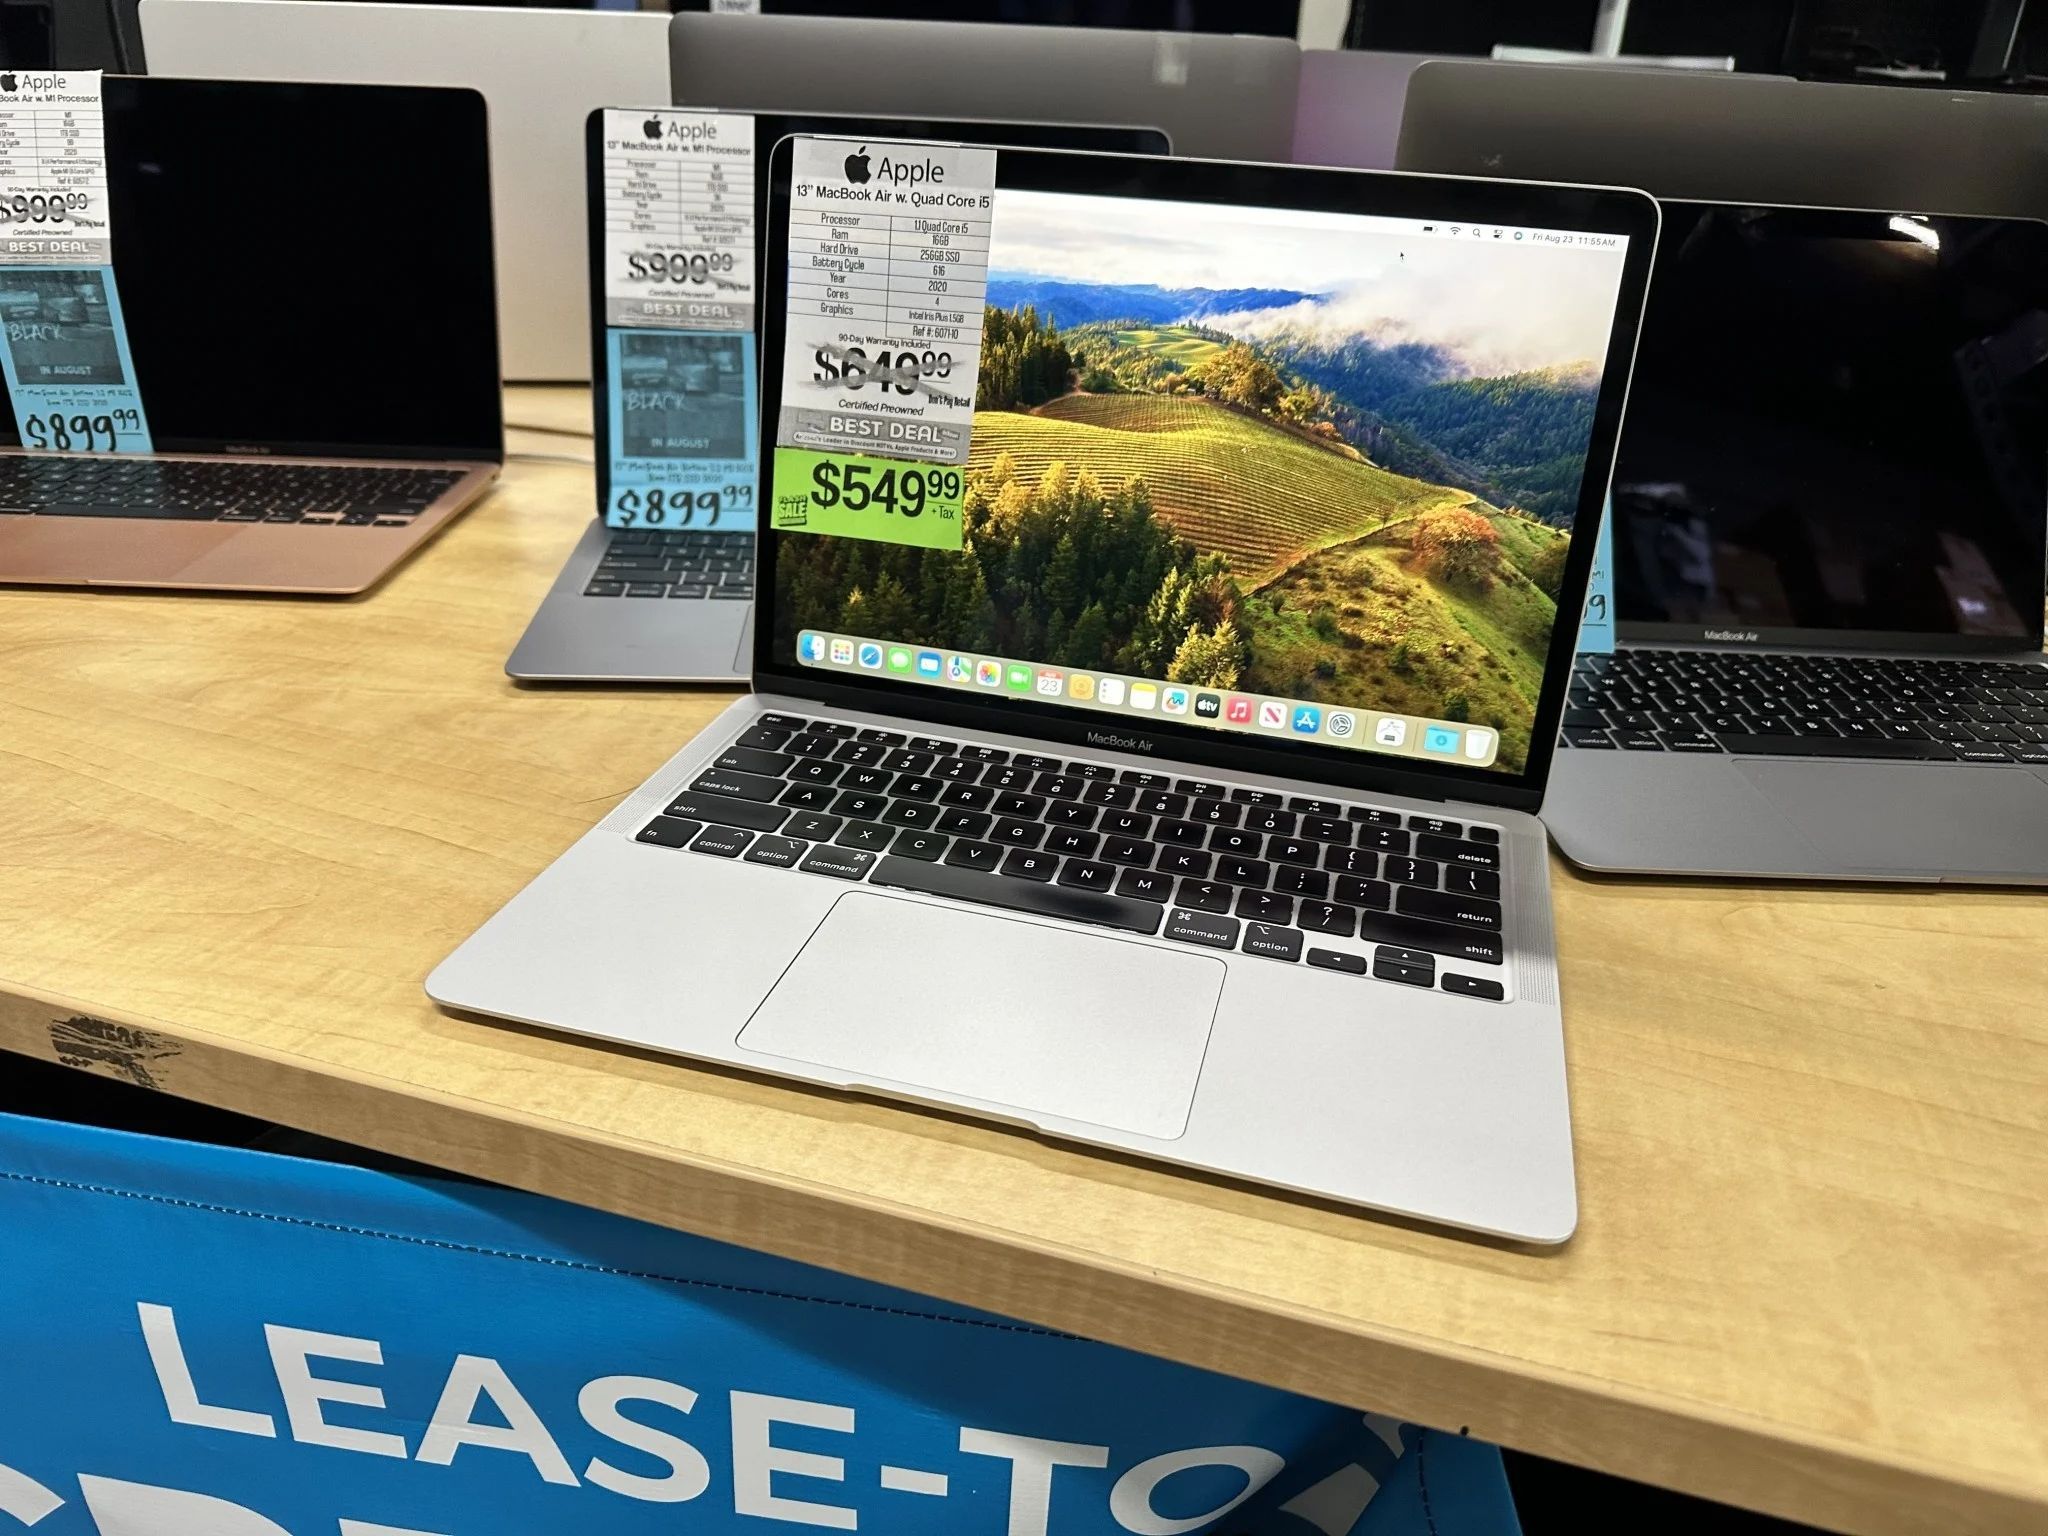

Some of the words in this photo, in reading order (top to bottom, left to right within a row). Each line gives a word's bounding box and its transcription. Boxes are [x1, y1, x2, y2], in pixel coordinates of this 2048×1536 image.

[22, 74, 66, 92] Apple
[58, 95, 98, 103] Processor
[668, 121, 717, 141] Apple
[622, 141, 663, 151] MacBook
[707, 146, 751, 156] Processor
[877, 157, 944, 187] Apple
[816, 187, 871, 201] MacBook
[875, 190, 893, 203] Air
[895, 194, 908, 204] w.
[911, 192, 943, 207] Quad
[946, 194, 975, 208] Core
[979, 196, 990, 208] i5
[821, 213, 860, 226] Processor
[922, 220, 941, 234] Quad
[942, 222, 960, 234] Core
[961, 223, 968, 234] i5
[832, 229, 848, 241] Ram
[932, 235, 949, 246] 16GB
[1532, 233, 1543, 241] Fri
[1545, 234, 1560, 244] Aug
[1562, 236, 1573, 244] 23
[9, 241, 45, 252] BEST
[50, 241, 89, 252] DEAL
[820, 243, 838, 254] Hard
[839, 244, 859, 255] Drive
[920, 250, 944, 262] 256GB
[945, 252, 960, 263] SSD
[812, 256, 843, 272] Battery
[844, 259, 865, 273] Cycle
[933, 265, 945, 276] 616
[830, 272, 846, 284] Year
[928, 281, 947, 293] 2020
[826, 288, 849, 300] Cores
[935, 297, 940, 306] 4
[643, 303, 684, 315] BEST
[689, 305, 732, 318] DEAL
[821, 303, 853, 318] Graphics
[935, 312, 948, 322] Plus
[913, 326, 925, 337] Ref
[838, 333, 864, 345] 90-Day
[866, 337, 899, 348] Warranty
[901, 340, 931, 349] Included
[54, 366, 92, 375] AUGUST
[838, 399, 879, 411] Certified
[880, 403, 924, 416] Preowned
[830, 416, 883, 437] BEST
[890, 422, 942, 443] DEAL
[667, 439, 710, 449] AUGUST
[939, 506, 954, 520] Tax
[1704, 629, 1743, 642] MacBook
[1745, 631, 1759, 642] Air
[1040, 679, 1058, 694] 23
[1087, 730, 1135, 747] MacBook
[1137, 739, 1153, 752] Air
[810, 767, 821, 775] Q
[860, 775, 873, 783] W
[699, 781, 720, 790] caps
[802, 792, 812, 800] A
[962, 792, 971, 800] R
[674, 805, 696, 813] shift
[854, 801, 863, 809] S
[1120, 819, 1130, 827] U
[646, 829, 657, 837] fn
[860, 831, 872, 839] X
[699, 840, 735, 851] control
[1067, 838, 1078, 846] H
[757, 850, 788, 861] option
[971, 850, 981, 858] V
[1458, 853, 1492, 864] delete
[809, 860, 858, 873] command
[1025, 860, 1034, 868] B
[1179, 857, 1190, 865] K
[1081, 870, 1093, 878] N
[1238, 867, 1246, 875] L
[1138, 880, 1152, 889] M
[1457, 912, 1492, 923] return
[1174, 926, 1227, 941] command
[1252, 940, 1289, 952] option
[1465, 945, 1493, 956] shift
[137, 1302, 1405, 1536] LEASE-TO
